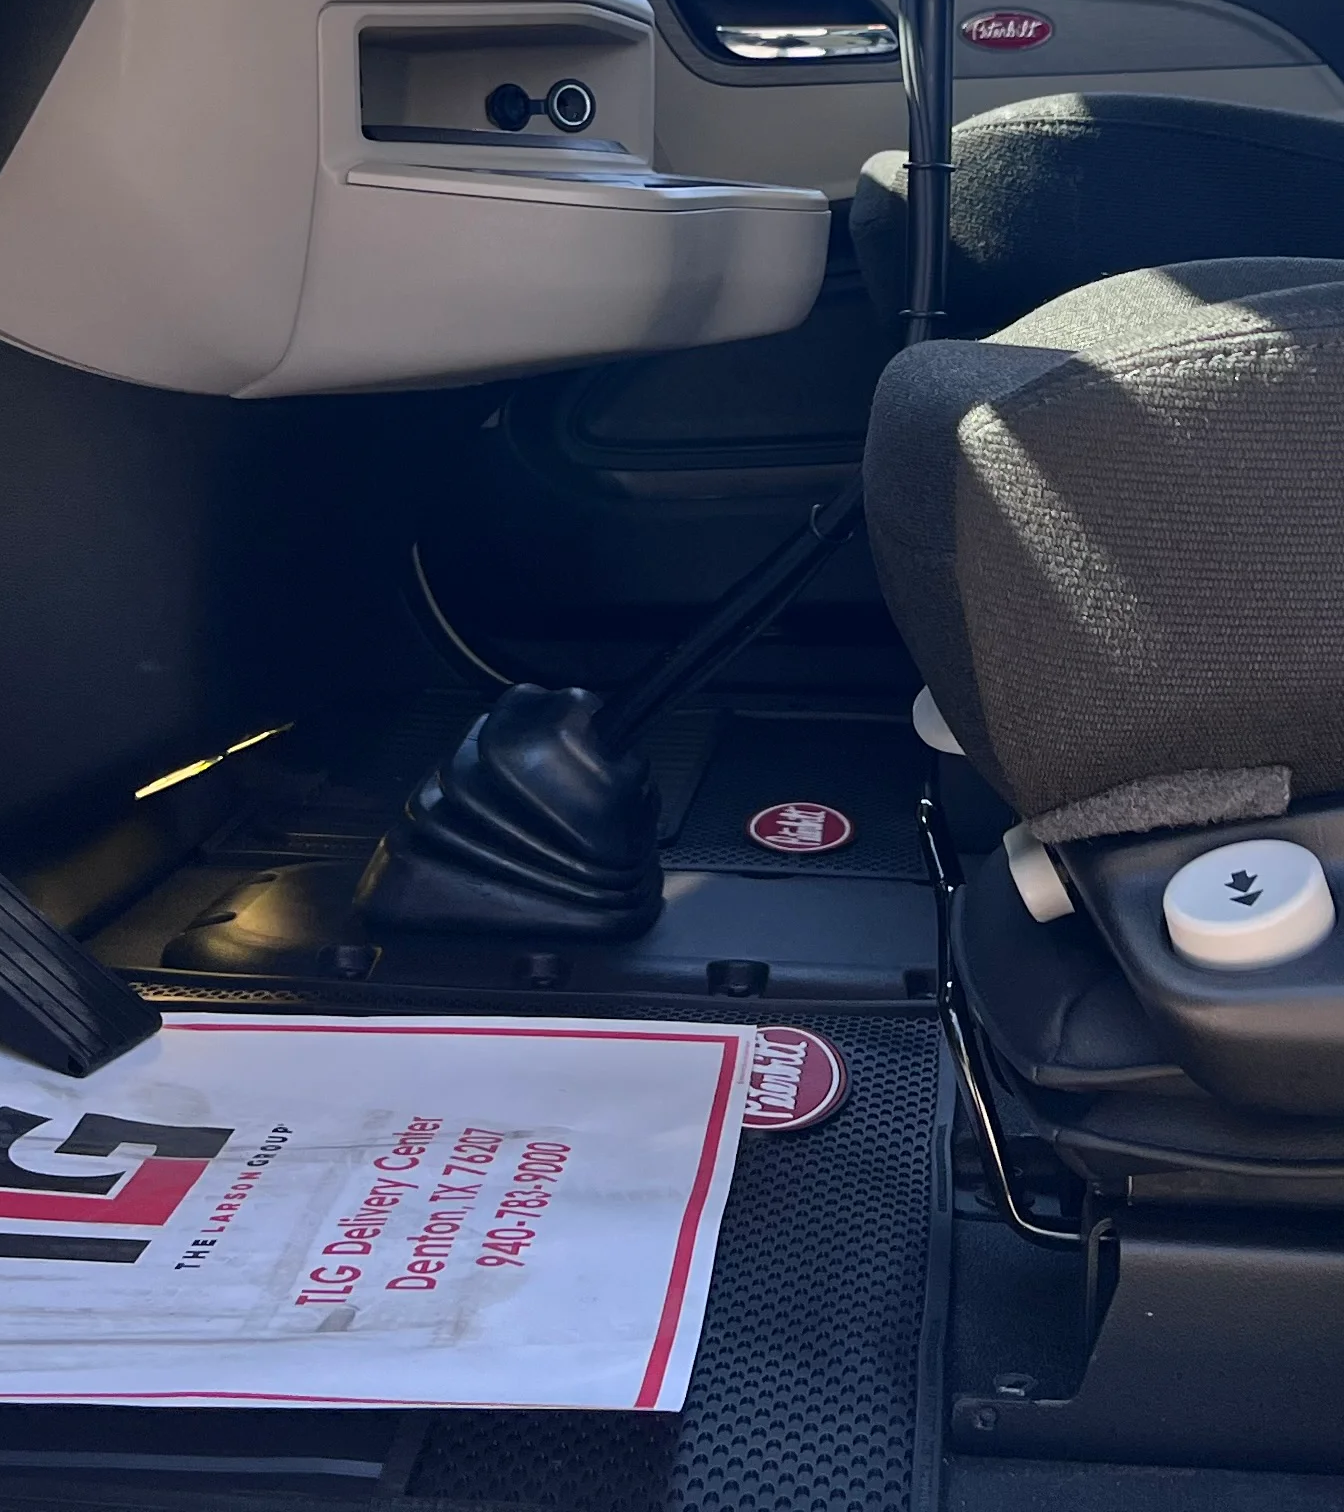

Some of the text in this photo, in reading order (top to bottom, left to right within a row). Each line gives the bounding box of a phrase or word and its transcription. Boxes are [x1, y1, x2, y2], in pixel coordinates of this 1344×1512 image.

[175, 1125, 293, 1270] THE LARSON GROUP
[295, 1115, 443, 1305] TLG Delivery Center
[385, 1127, 505, 1290] Denton, TX 76207
[475, 1141, 571, 1267] 940-783-9000
